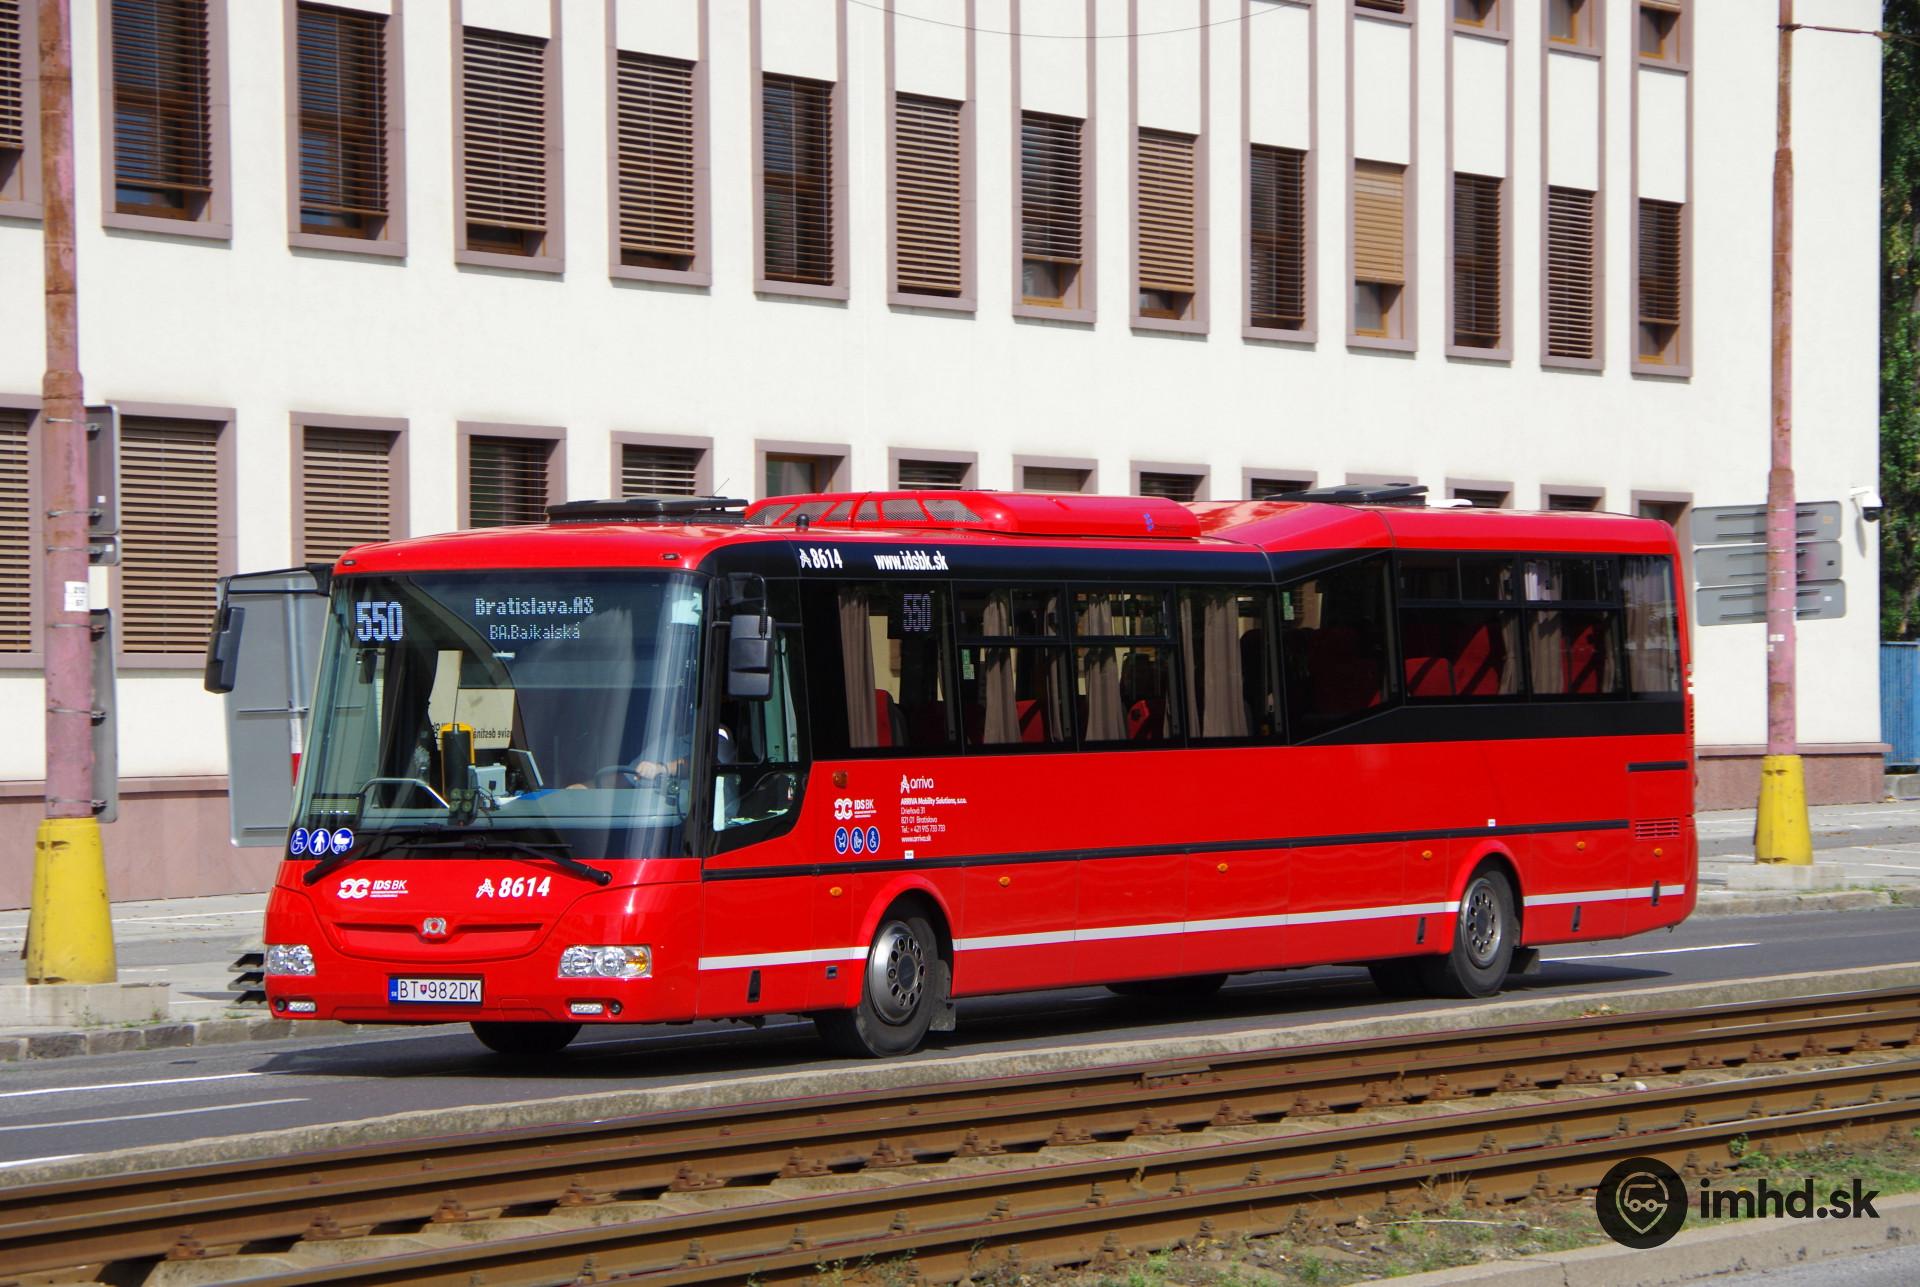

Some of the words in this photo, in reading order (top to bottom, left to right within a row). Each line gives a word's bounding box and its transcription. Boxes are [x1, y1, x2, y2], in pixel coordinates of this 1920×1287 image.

[809, 548, 843, 569] 8614
[874, 550, 949, 571] www.idsbk.sk
[356, 601, 404, 642] 550
[903, 593, 932, 632] 550
[910, 775, 934, 789] arriva
[854, 799, 865, 810] IDS
[865, 798, 874, 810] BK
[372, 879, 392, 891] IDS
[392, 879, 408, 890] BK
[498, 876, 551, 898] 8614
[400, 980, 419, 999] BT
[428, 981, 479, 1001] 982DK
